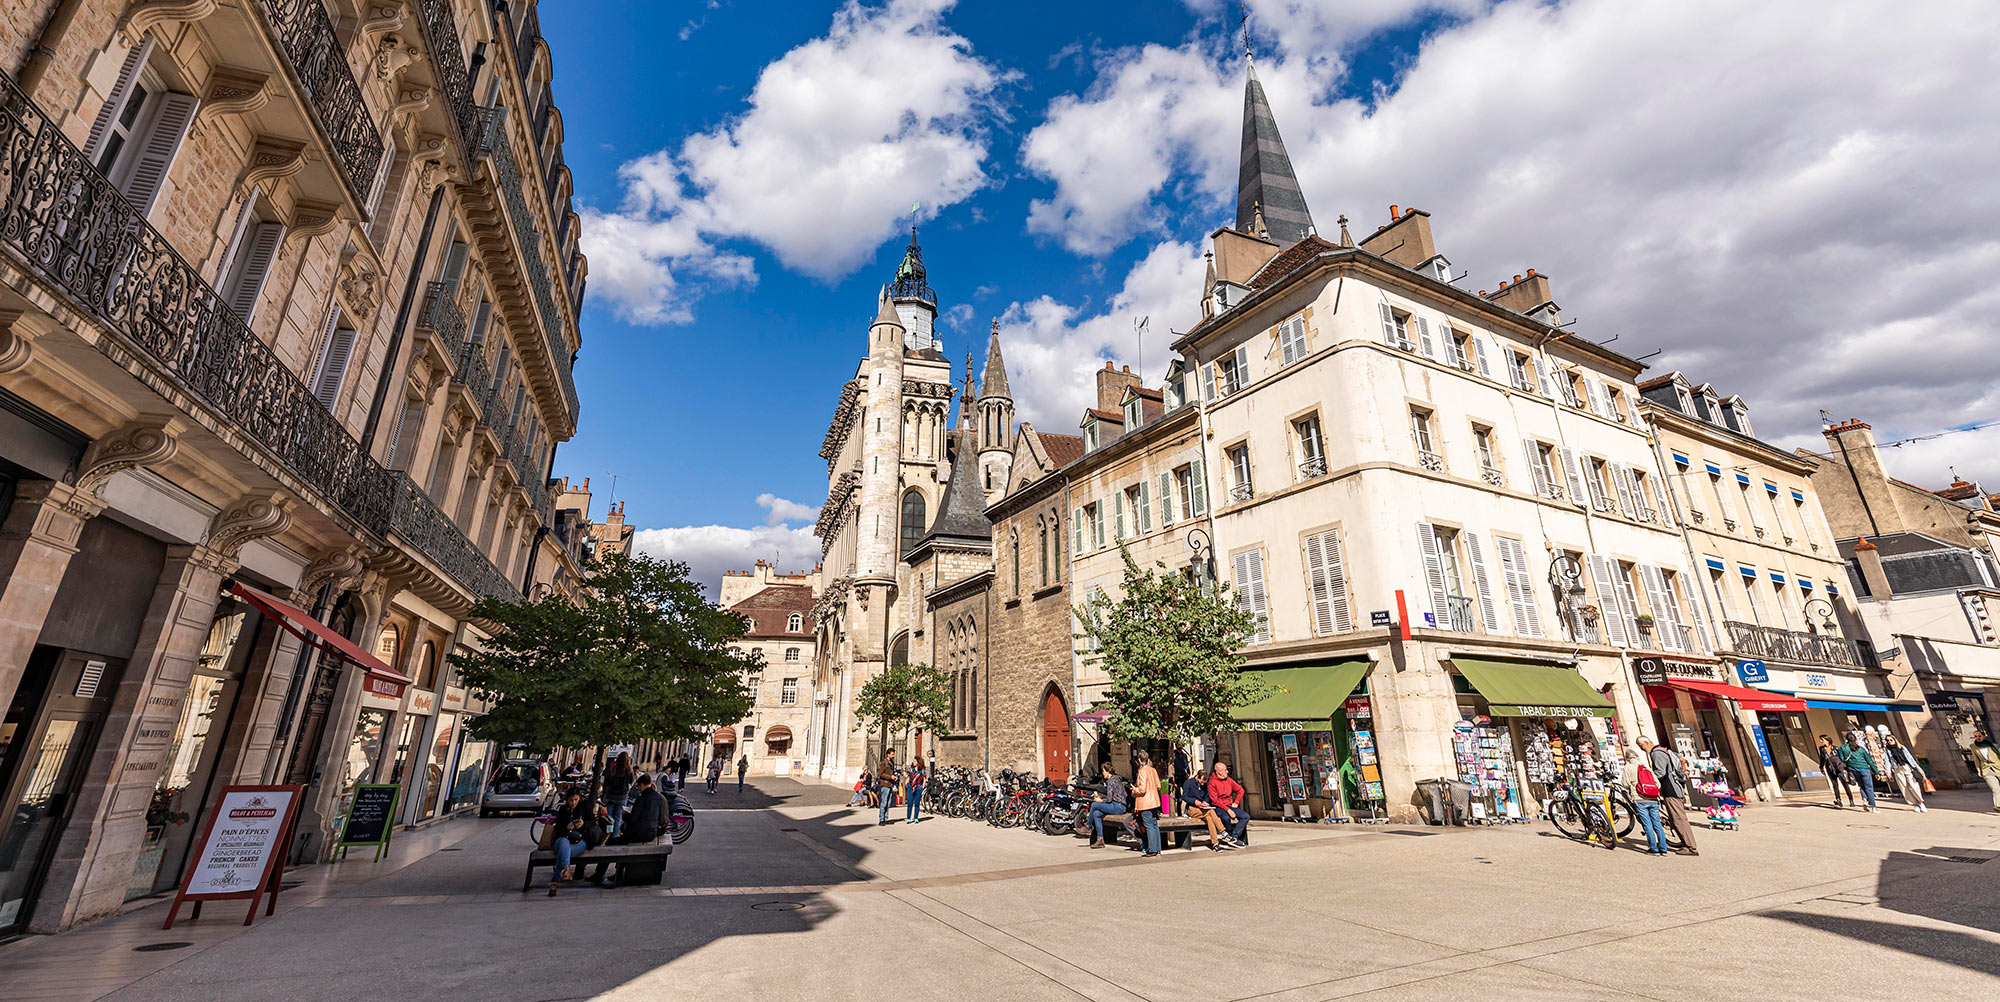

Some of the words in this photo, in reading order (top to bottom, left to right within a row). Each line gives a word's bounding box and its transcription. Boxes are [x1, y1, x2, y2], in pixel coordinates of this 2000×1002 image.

[1743, 662, 1758, 675] G
[1806, 673, 1828, 687] GIBERT
[149, 696, 179, 706] CONFISERIE
[1517, 705, 1547, 716] TABAC
[1550, 706, 1567, 716] DES
[1571, 707, 1593, 717] DUCS
[1248, 722, 1268, 731] DES
[1273, 721, 1303, 731] DUCS
[239, 828, 270, 836] D'ÉPICES
